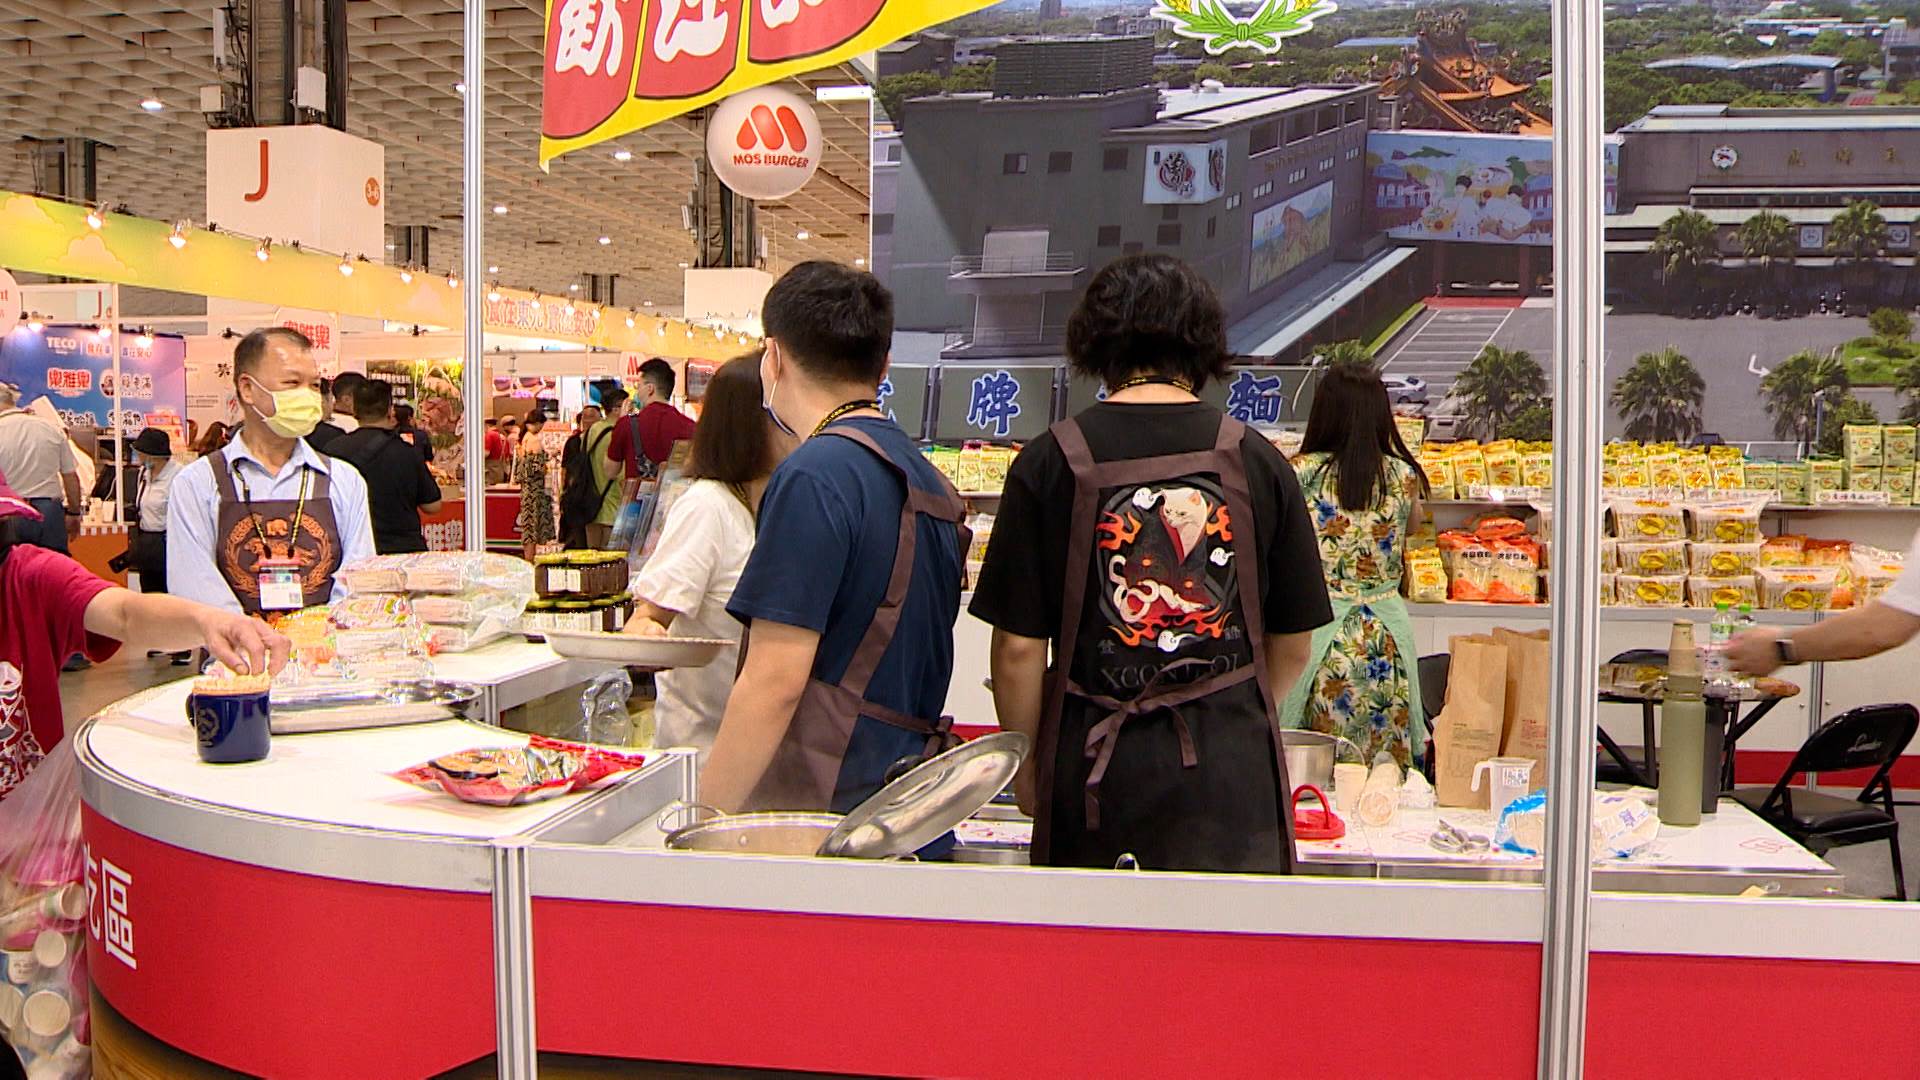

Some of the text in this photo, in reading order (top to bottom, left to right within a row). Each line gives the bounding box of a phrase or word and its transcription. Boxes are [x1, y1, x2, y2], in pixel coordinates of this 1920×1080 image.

[244, 140, 269, 201] J
[733, 153, 809, 168] MOS BURGER
[47, 337, 77, 350] TECO
[968, 369, 1021, 436] 牌
